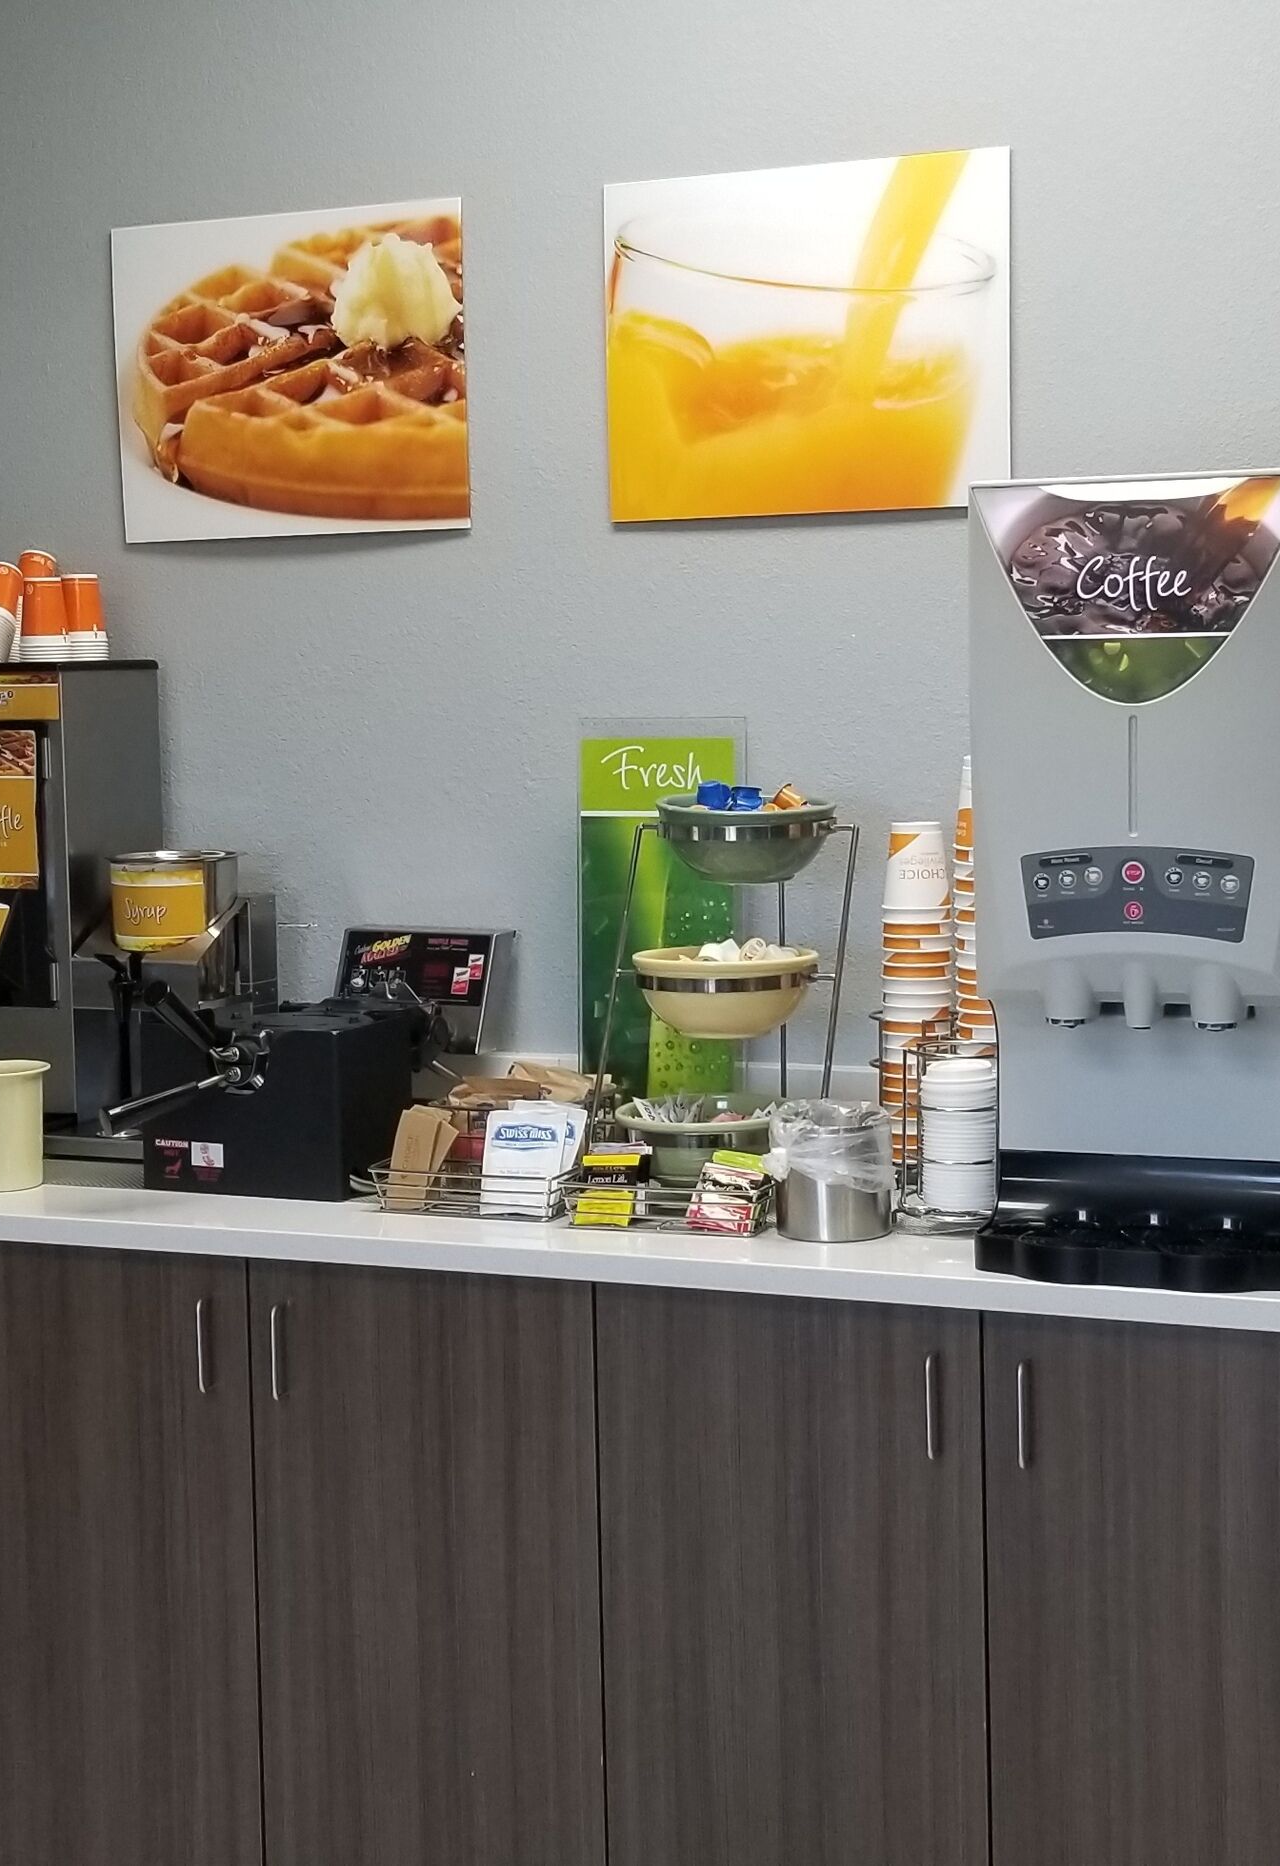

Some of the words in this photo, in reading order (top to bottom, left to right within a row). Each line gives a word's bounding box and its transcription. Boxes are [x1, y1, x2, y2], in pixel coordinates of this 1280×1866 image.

[1076, 555, 1192, 612] Coffee
[600, 745, 702, 790] Fresh
[899, 868, 945, 880] CHOICE
[123, 897, 168, 925] Syrup
[155, 1138, 189, 1148] CAUTION
